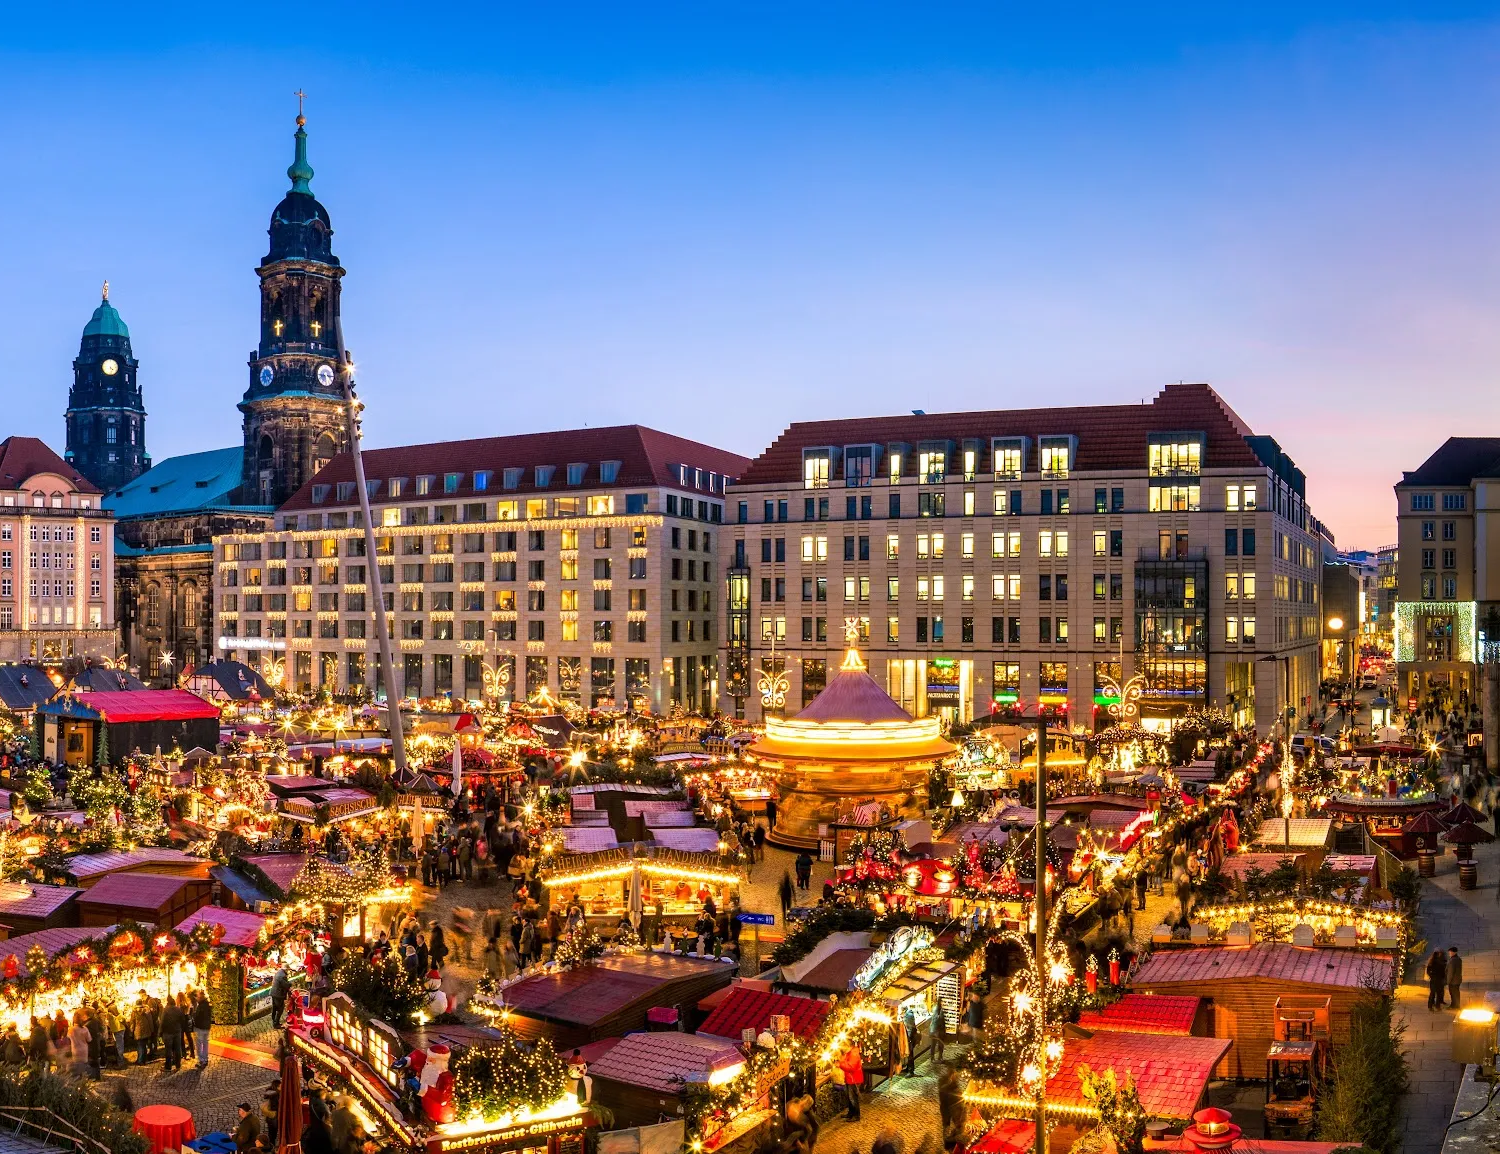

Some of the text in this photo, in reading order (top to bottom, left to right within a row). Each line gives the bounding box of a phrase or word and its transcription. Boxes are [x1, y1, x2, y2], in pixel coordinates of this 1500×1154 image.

[398, 793, 441, 806] GLÜHEINE
[599, 848, 625, 863] WEIN
[658, 851, 723, 868] HANDBROTE
[441, 1116, 583, 1151] Rostbratwurst Glühwein
